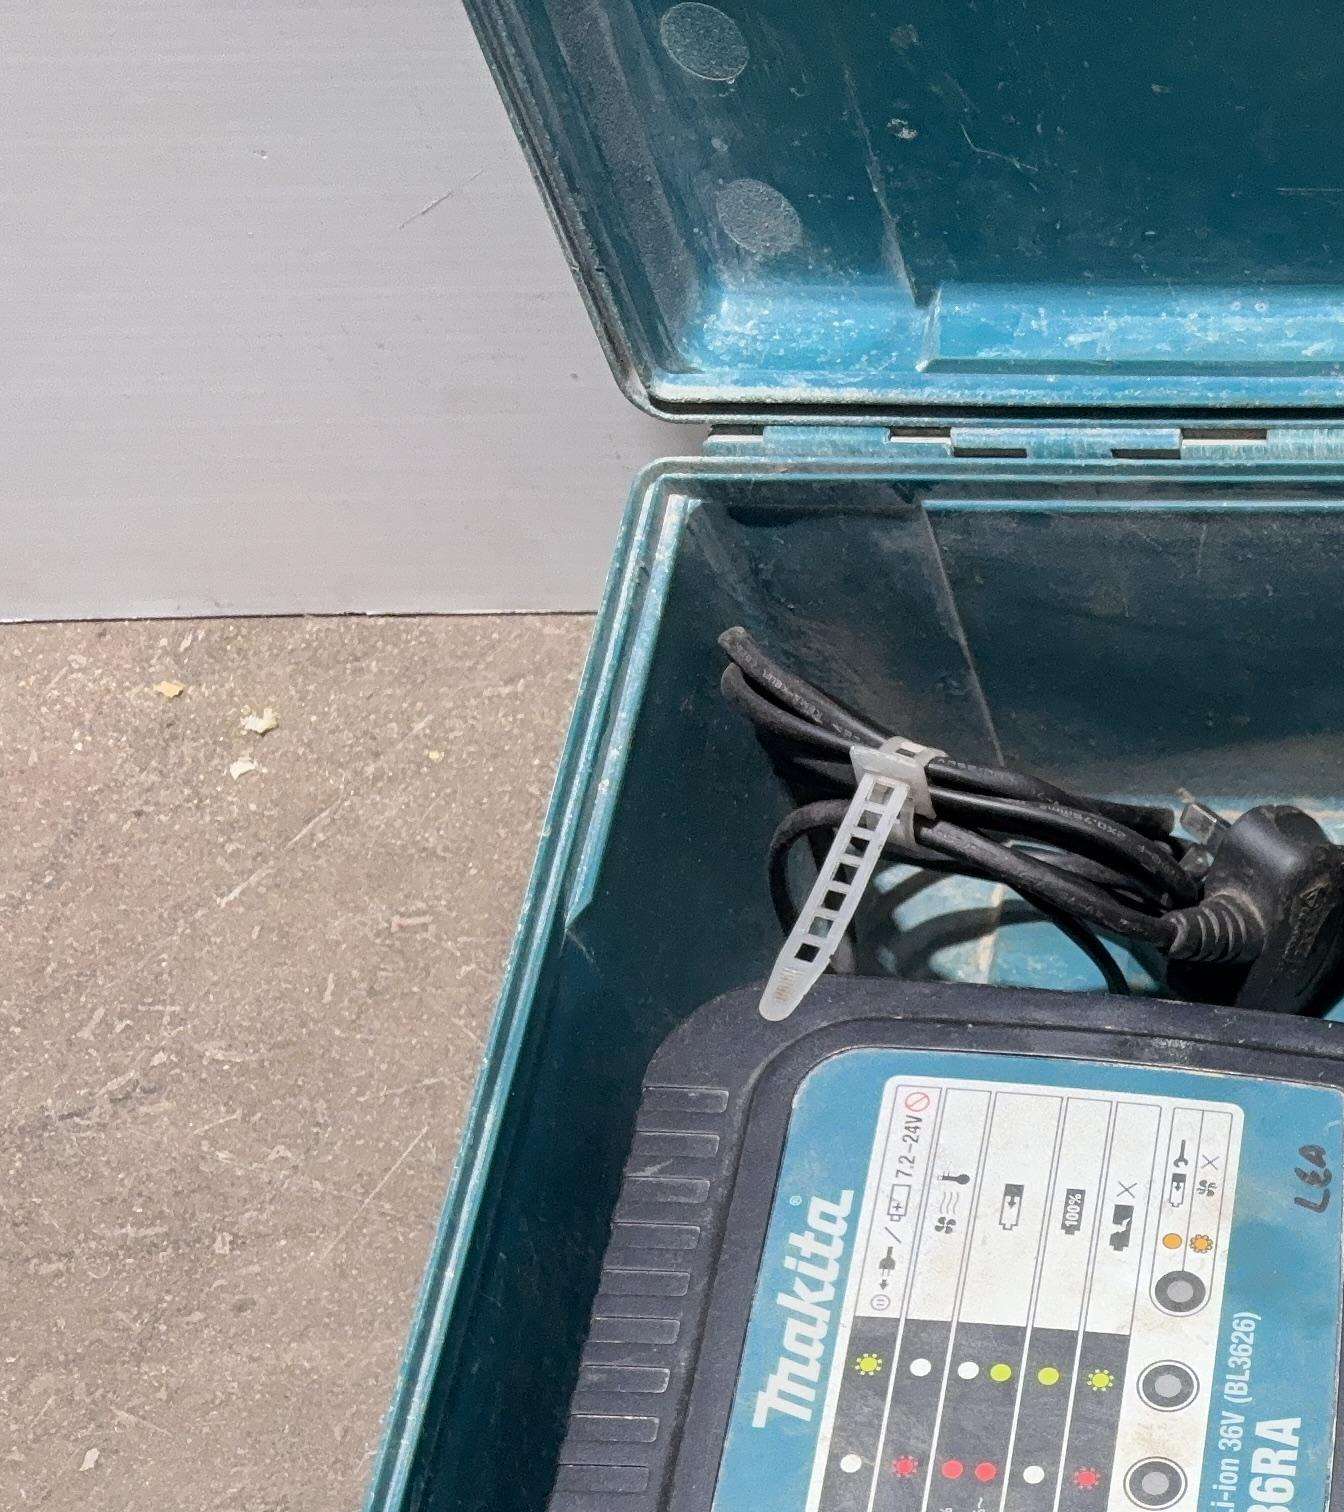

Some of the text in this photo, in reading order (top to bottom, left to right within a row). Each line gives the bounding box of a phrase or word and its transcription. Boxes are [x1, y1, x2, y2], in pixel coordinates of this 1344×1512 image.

[1064, 1193, 1082, 1227] 100%
[1223, 1311, 1262, 1404] (BL3626)
[1220, 1411, 1246, 1452] 36V
